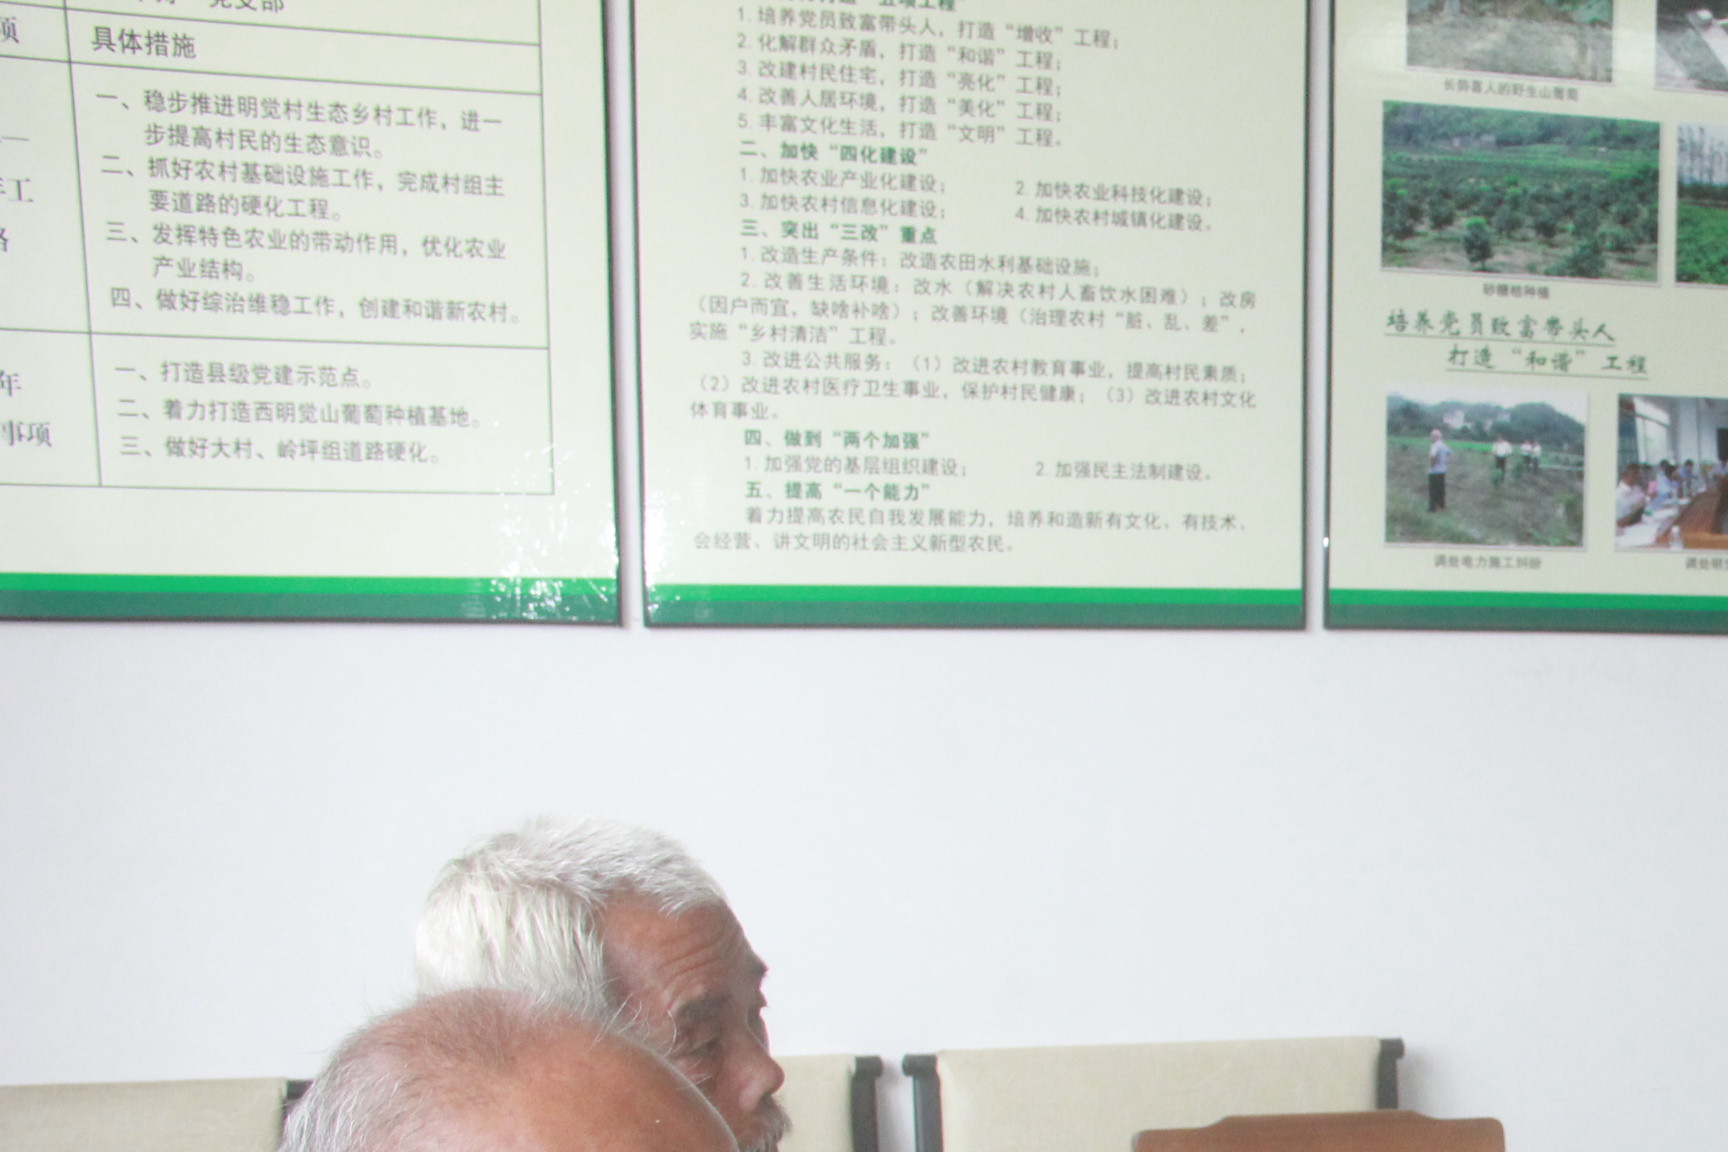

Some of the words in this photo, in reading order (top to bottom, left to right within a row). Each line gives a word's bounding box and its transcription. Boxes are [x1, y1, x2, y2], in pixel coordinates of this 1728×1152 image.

[91, 25, 197, 60] 具体措施
[152, 255, 255, 283] 产业结构。
